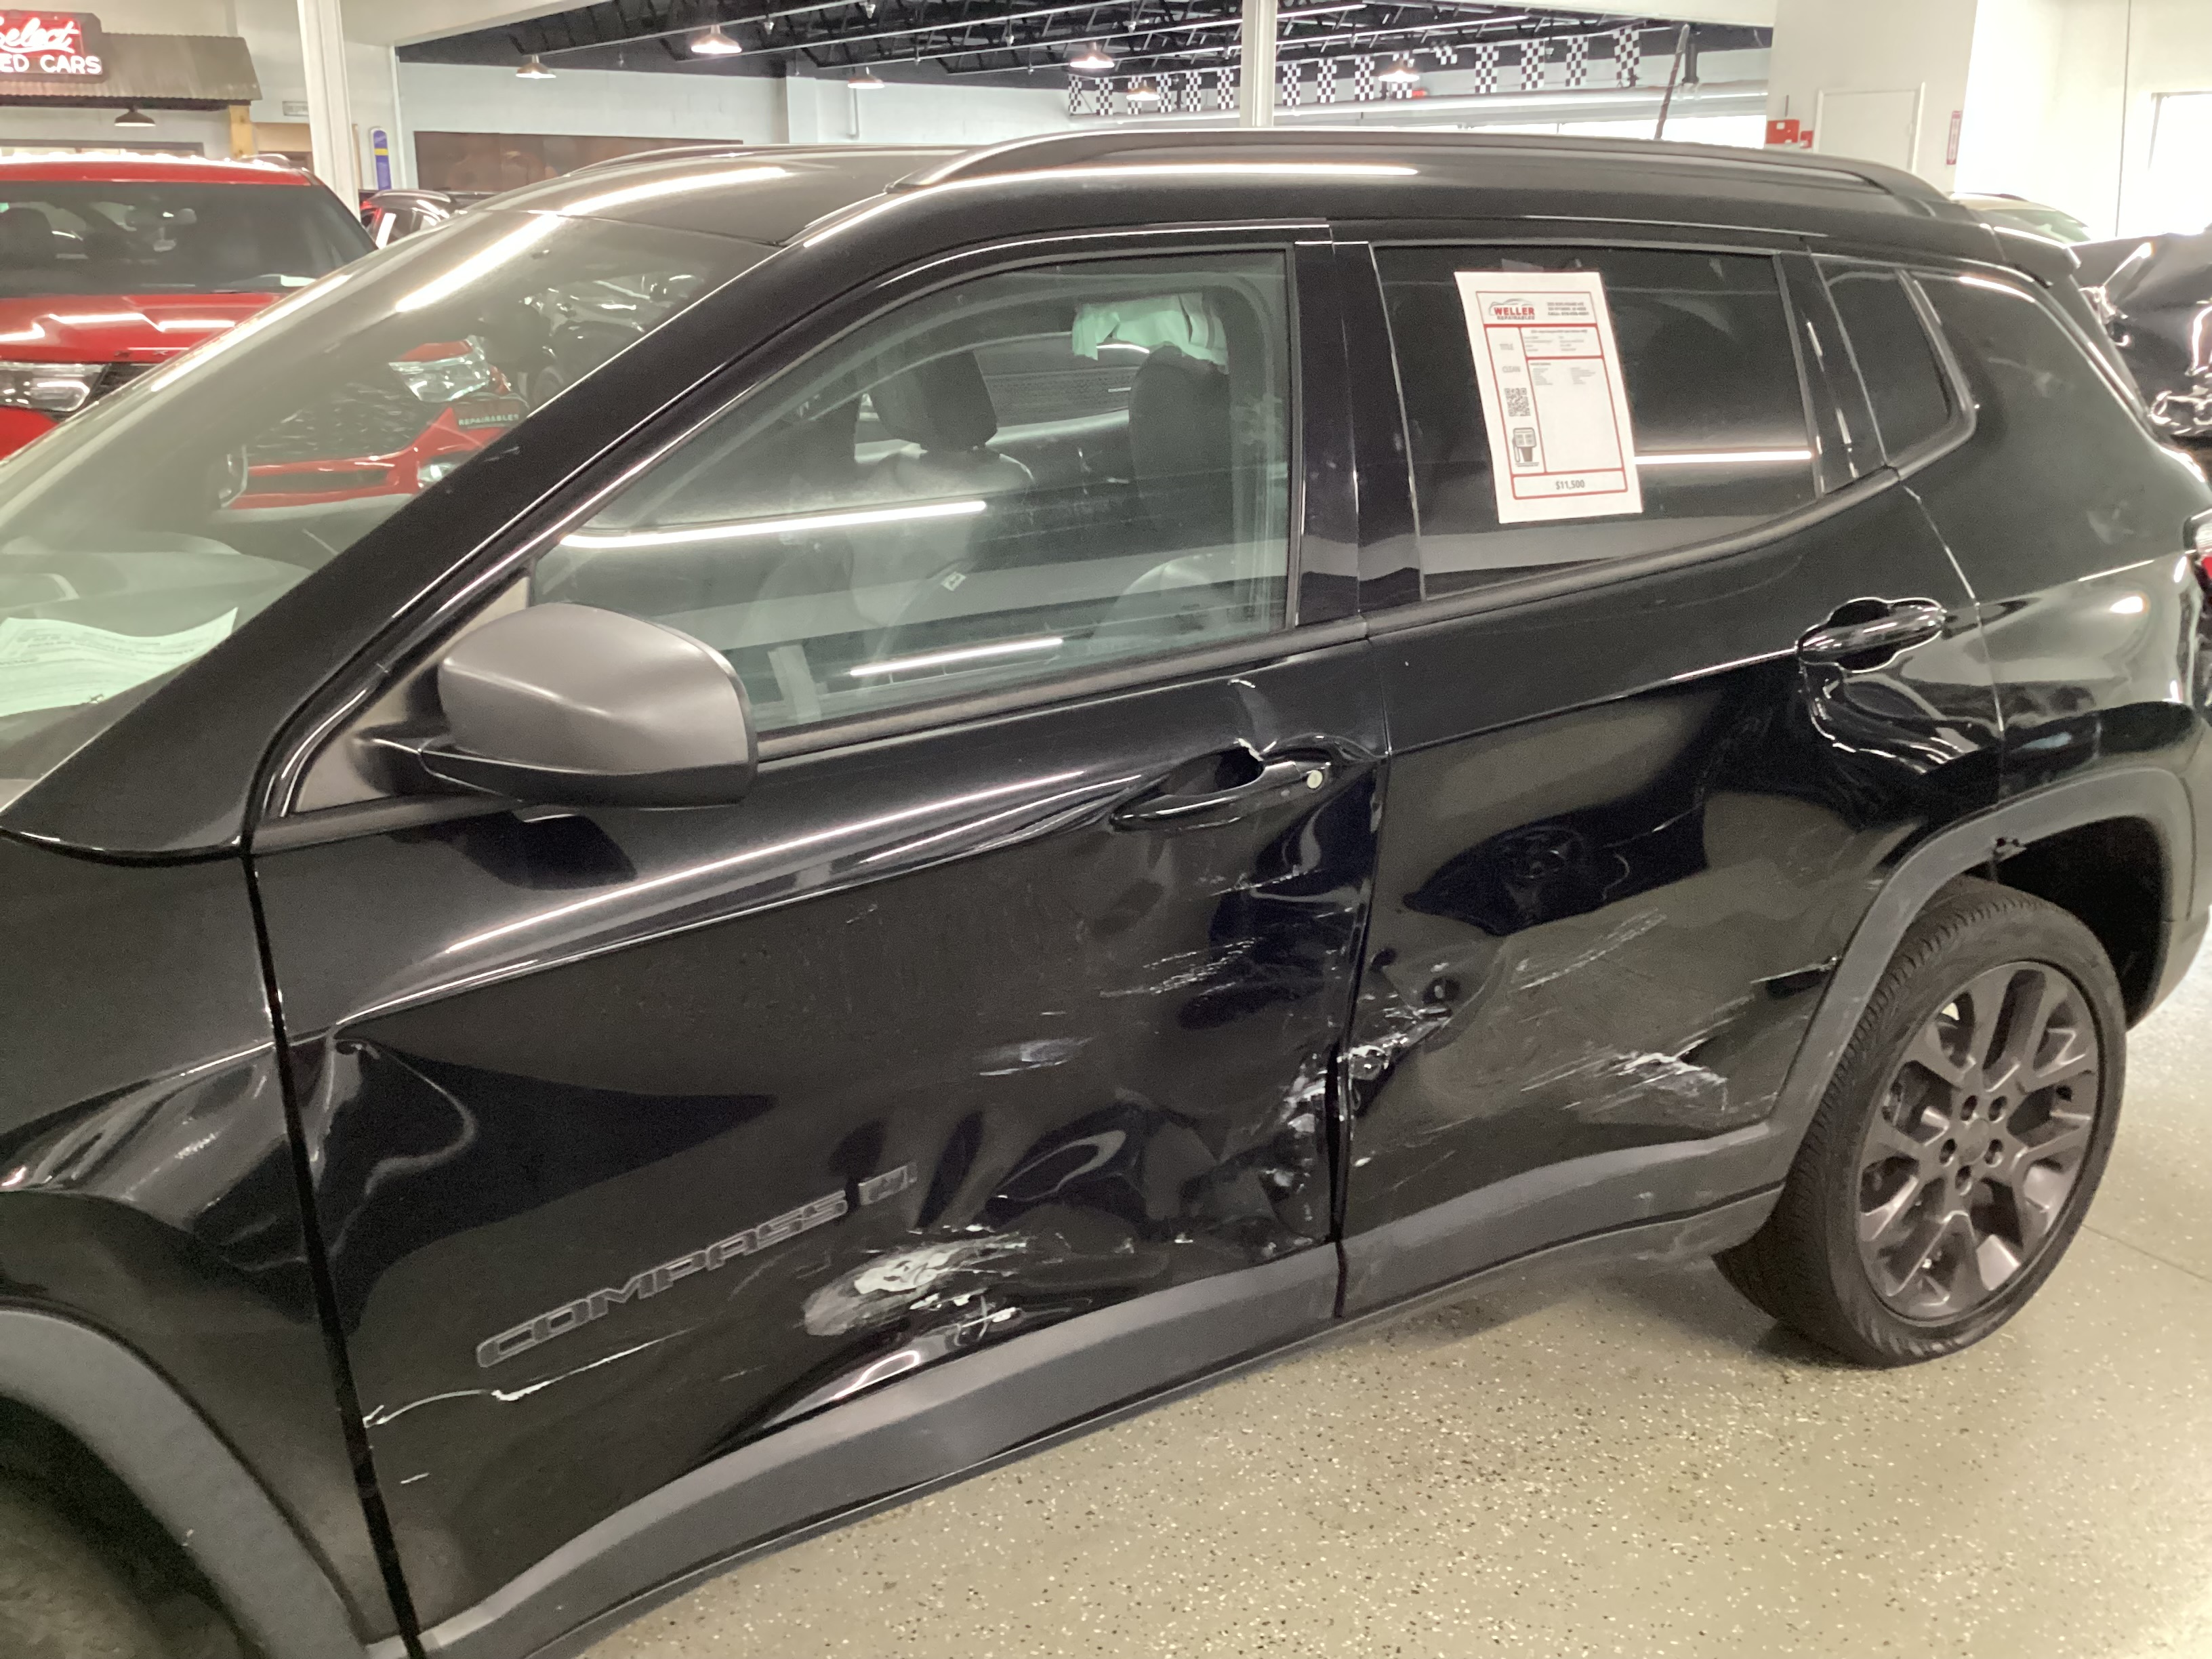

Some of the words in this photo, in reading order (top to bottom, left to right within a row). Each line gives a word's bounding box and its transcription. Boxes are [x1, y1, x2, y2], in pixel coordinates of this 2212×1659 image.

[39, 54, 102, 75] CARS
[1493, 307, 1534, 316] WELLER
[1555, 479, 1585, 490] $11,500
[476, 1190, 848, 1368] COMPASS
